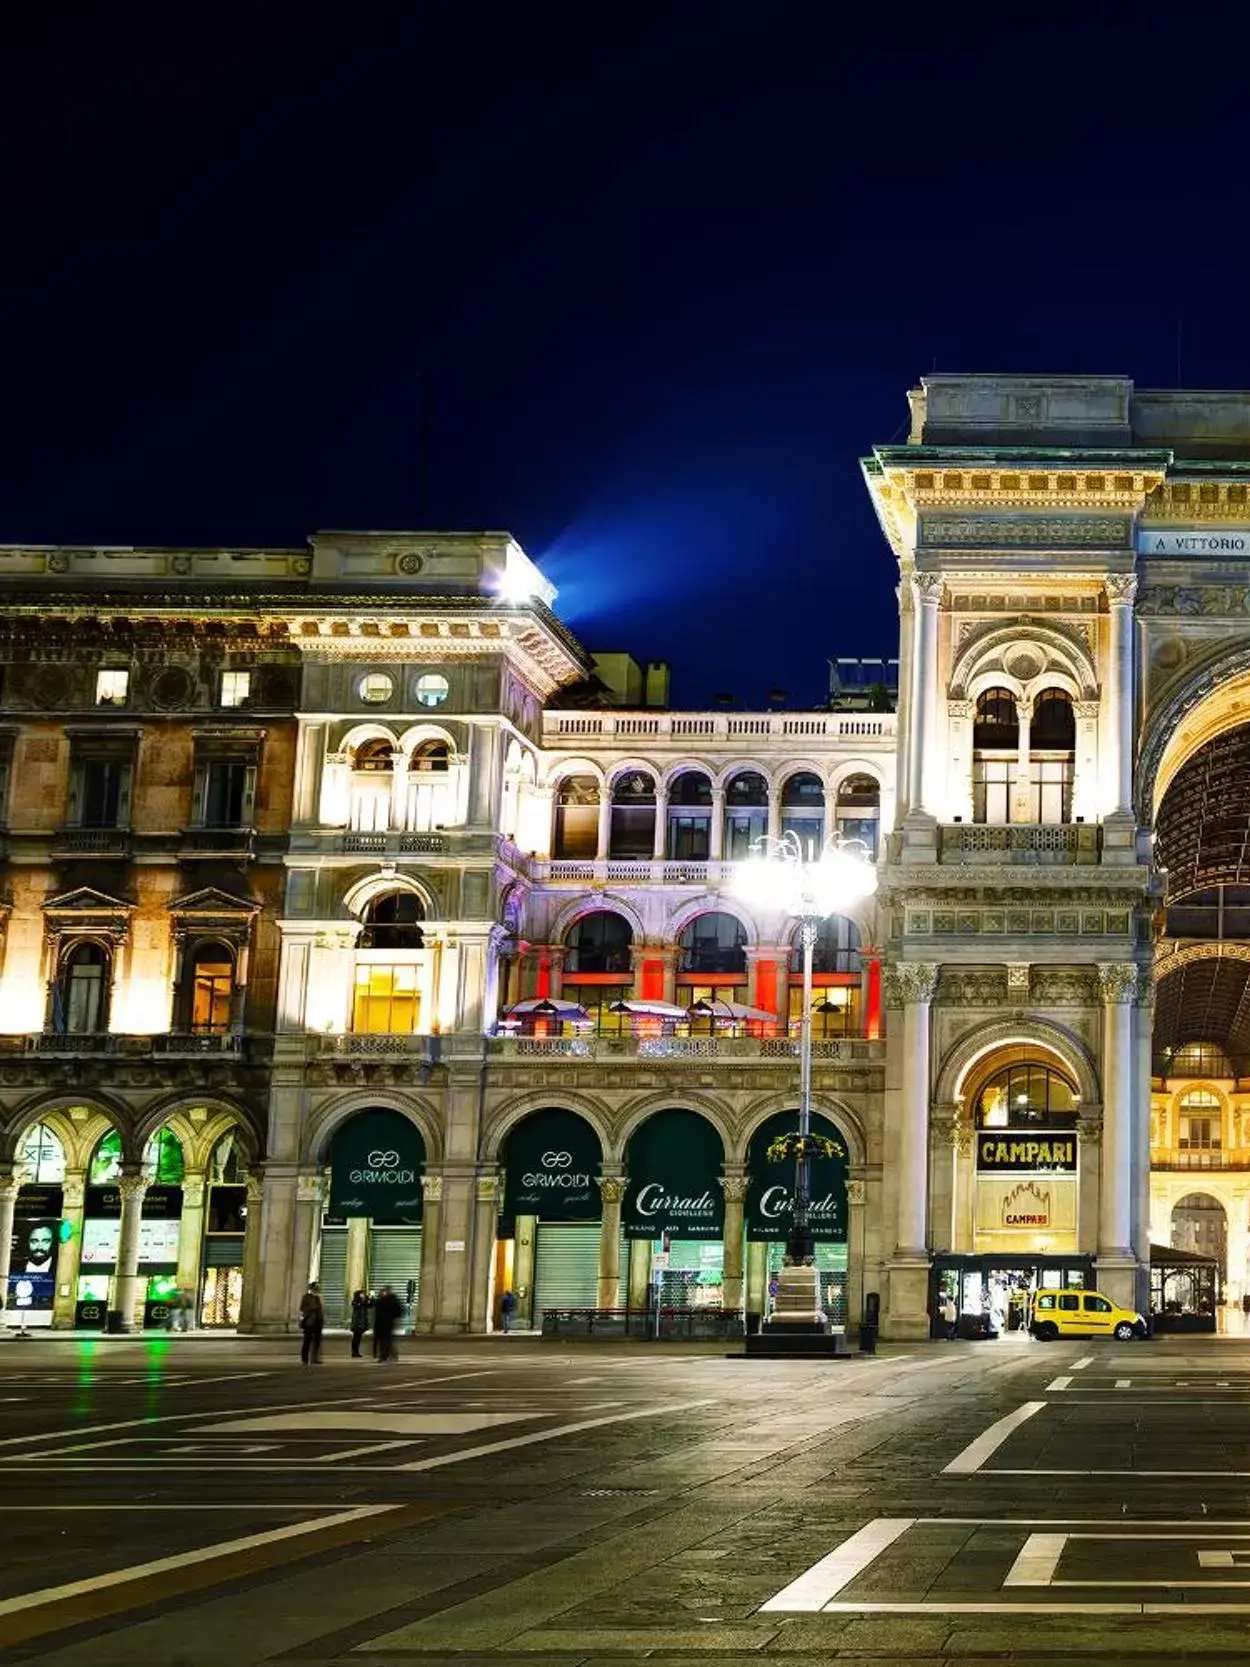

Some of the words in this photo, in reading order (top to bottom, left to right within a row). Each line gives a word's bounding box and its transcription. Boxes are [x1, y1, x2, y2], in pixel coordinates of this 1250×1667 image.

[1155, 537, 1166, 550] A
[1176, 538, 1245, 551] VITTORIO
[982, 1142, 1073, 1163] CAMPARI
[349, 1169, 414, 1184] GRIMOLDI
[521, 1172, 590, 1188] GRIMOLDI
[636, 1183, 715, 1216] Currado
[760, 1185, 838, 1218] Curado
[1005, 1214, 1048, 1224] CAMPARI
